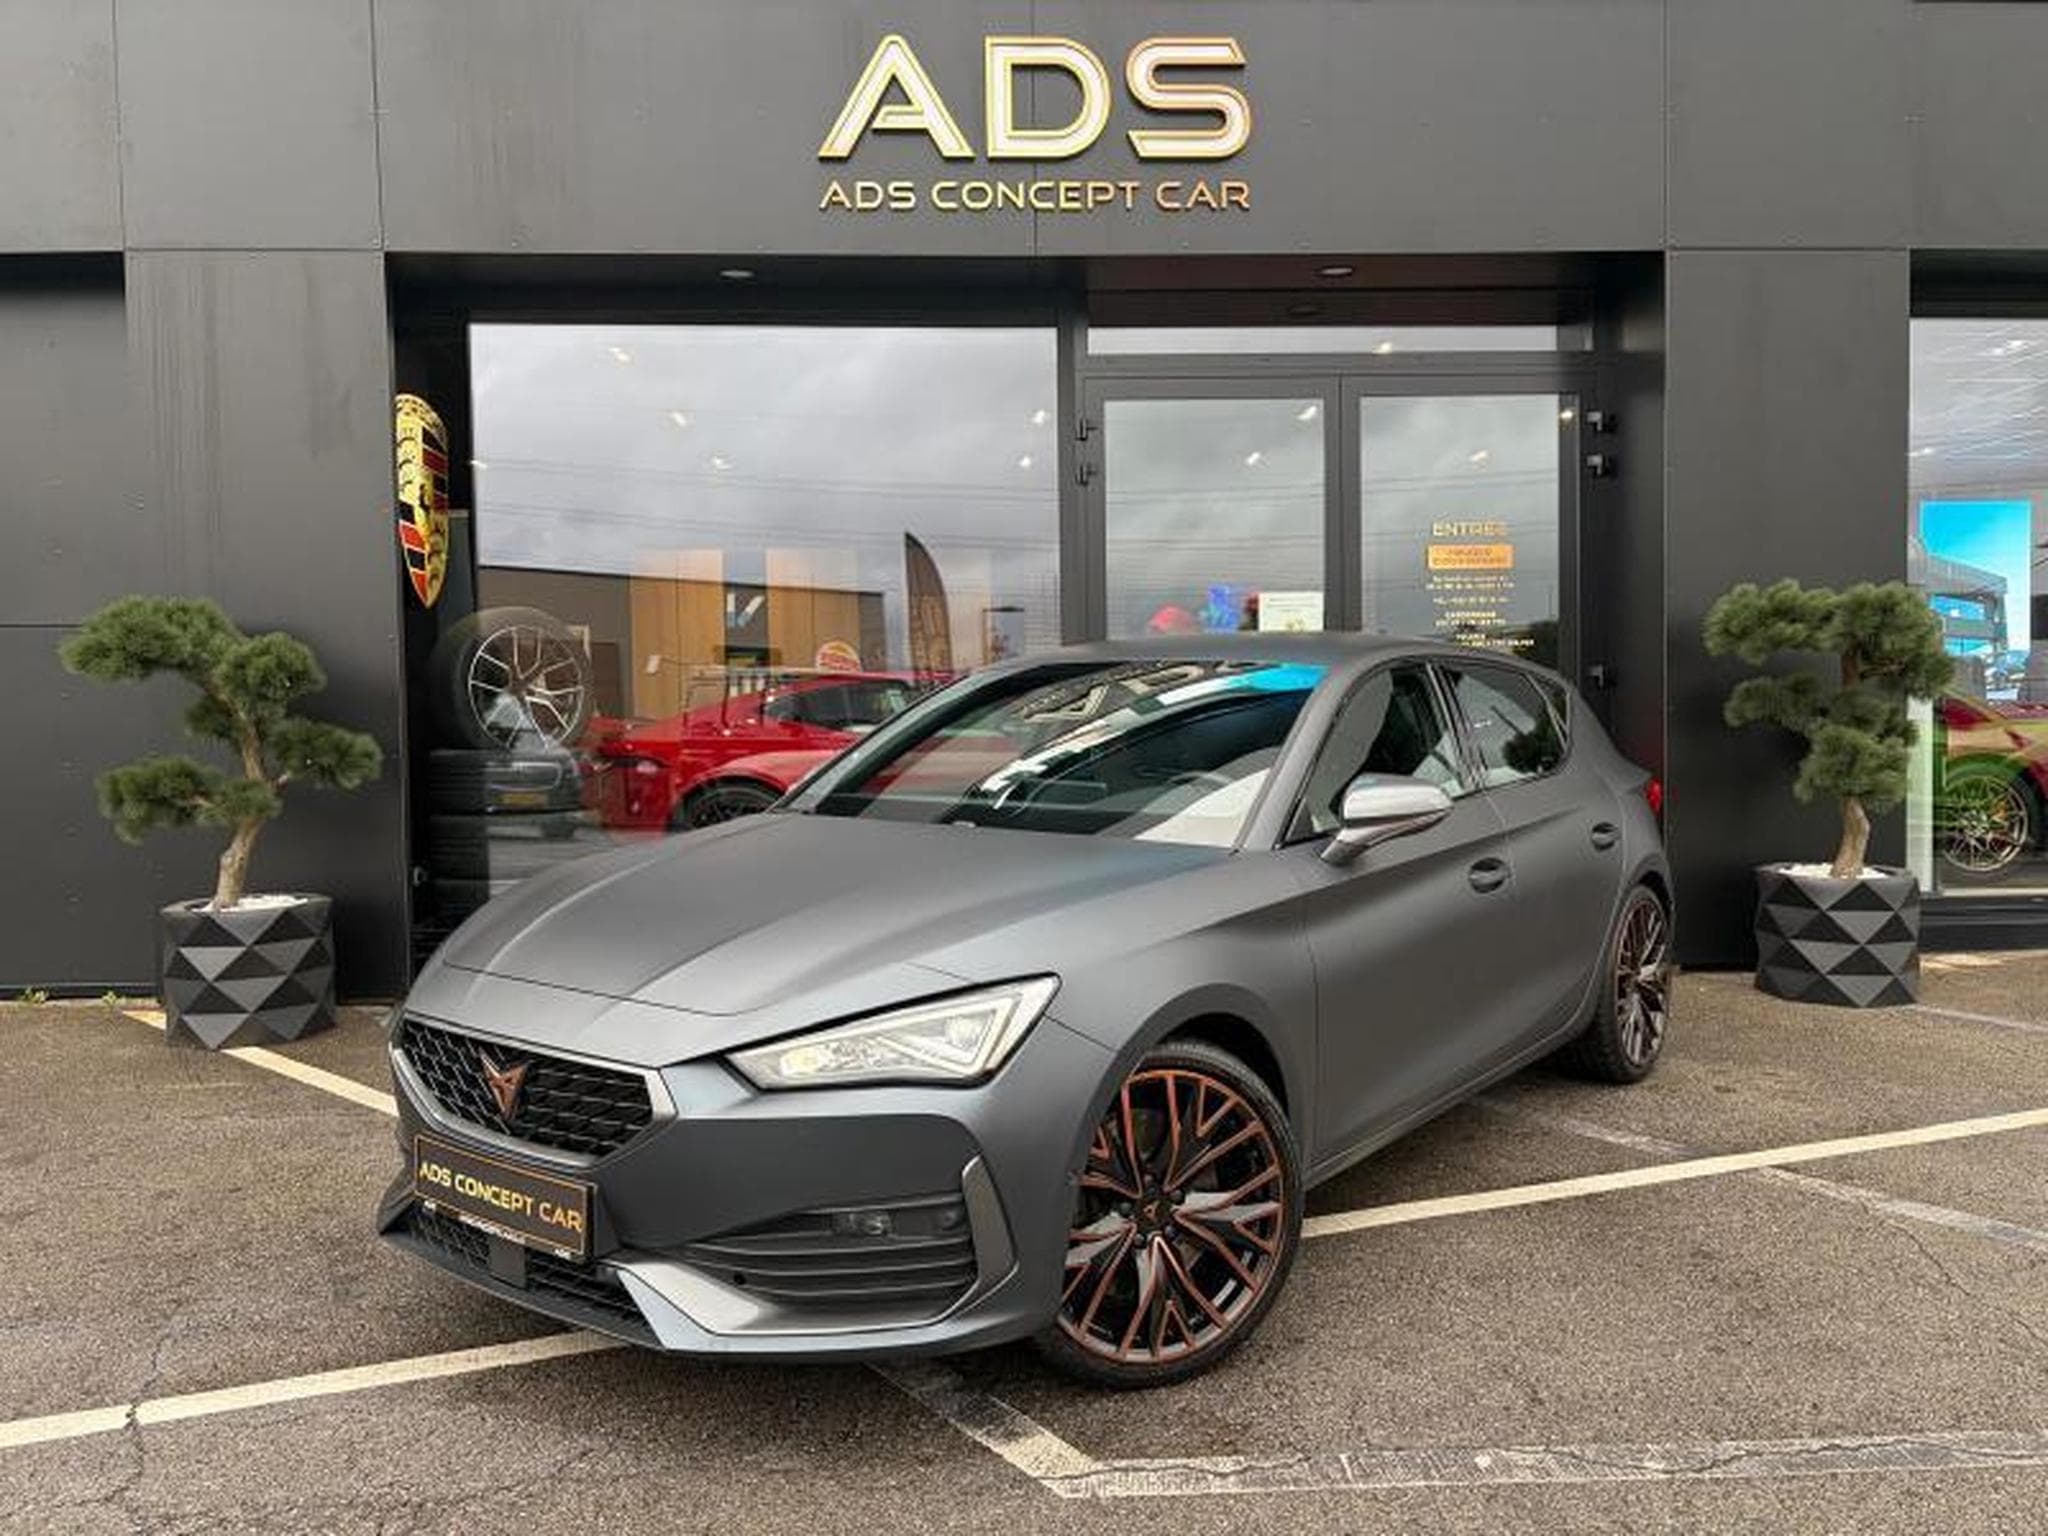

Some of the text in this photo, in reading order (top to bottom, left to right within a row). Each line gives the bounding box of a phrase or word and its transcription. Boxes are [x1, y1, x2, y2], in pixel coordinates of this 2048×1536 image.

[818, 33, 1252, 160] ADS
[818, 180, 1252, 210] ADS CONCEPT CAR
[419, 1161, 452, 1187] ADS
[454, 1173, 535, 1217] CONCEPT
[538, 1202, 584, 1233] CAR
